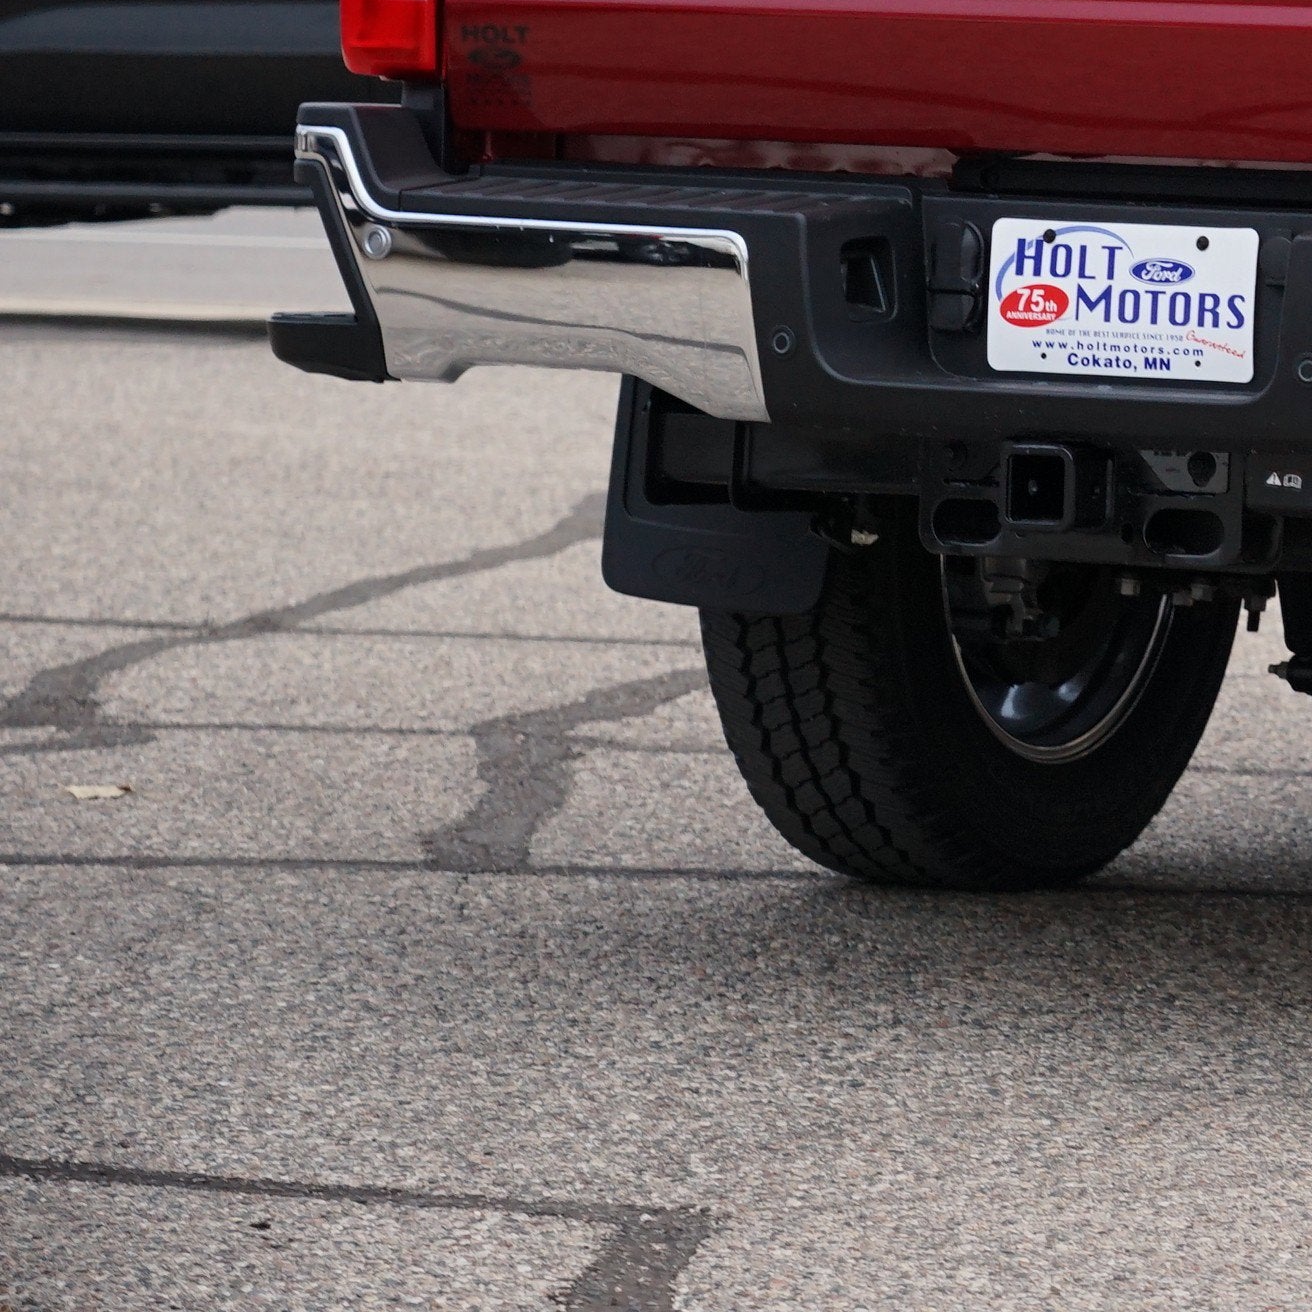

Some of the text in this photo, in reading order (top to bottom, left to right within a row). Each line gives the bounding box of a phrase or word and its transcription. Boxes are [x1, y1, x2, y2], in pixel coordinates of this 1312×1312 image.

[461, 23, 530, 45] HOLT
[1015, 238, 1123, 281] HOLT
[1016, 288, 1058, 313] 75th
[1075, 284, 1246, 330] MOTORS
[1005, 310, 1057, 321] ANNIVERSARY
[1032, 340, 1204, 357] www.holtmotors.com
[1067, 352, 1171, 372] Cokato, MN
